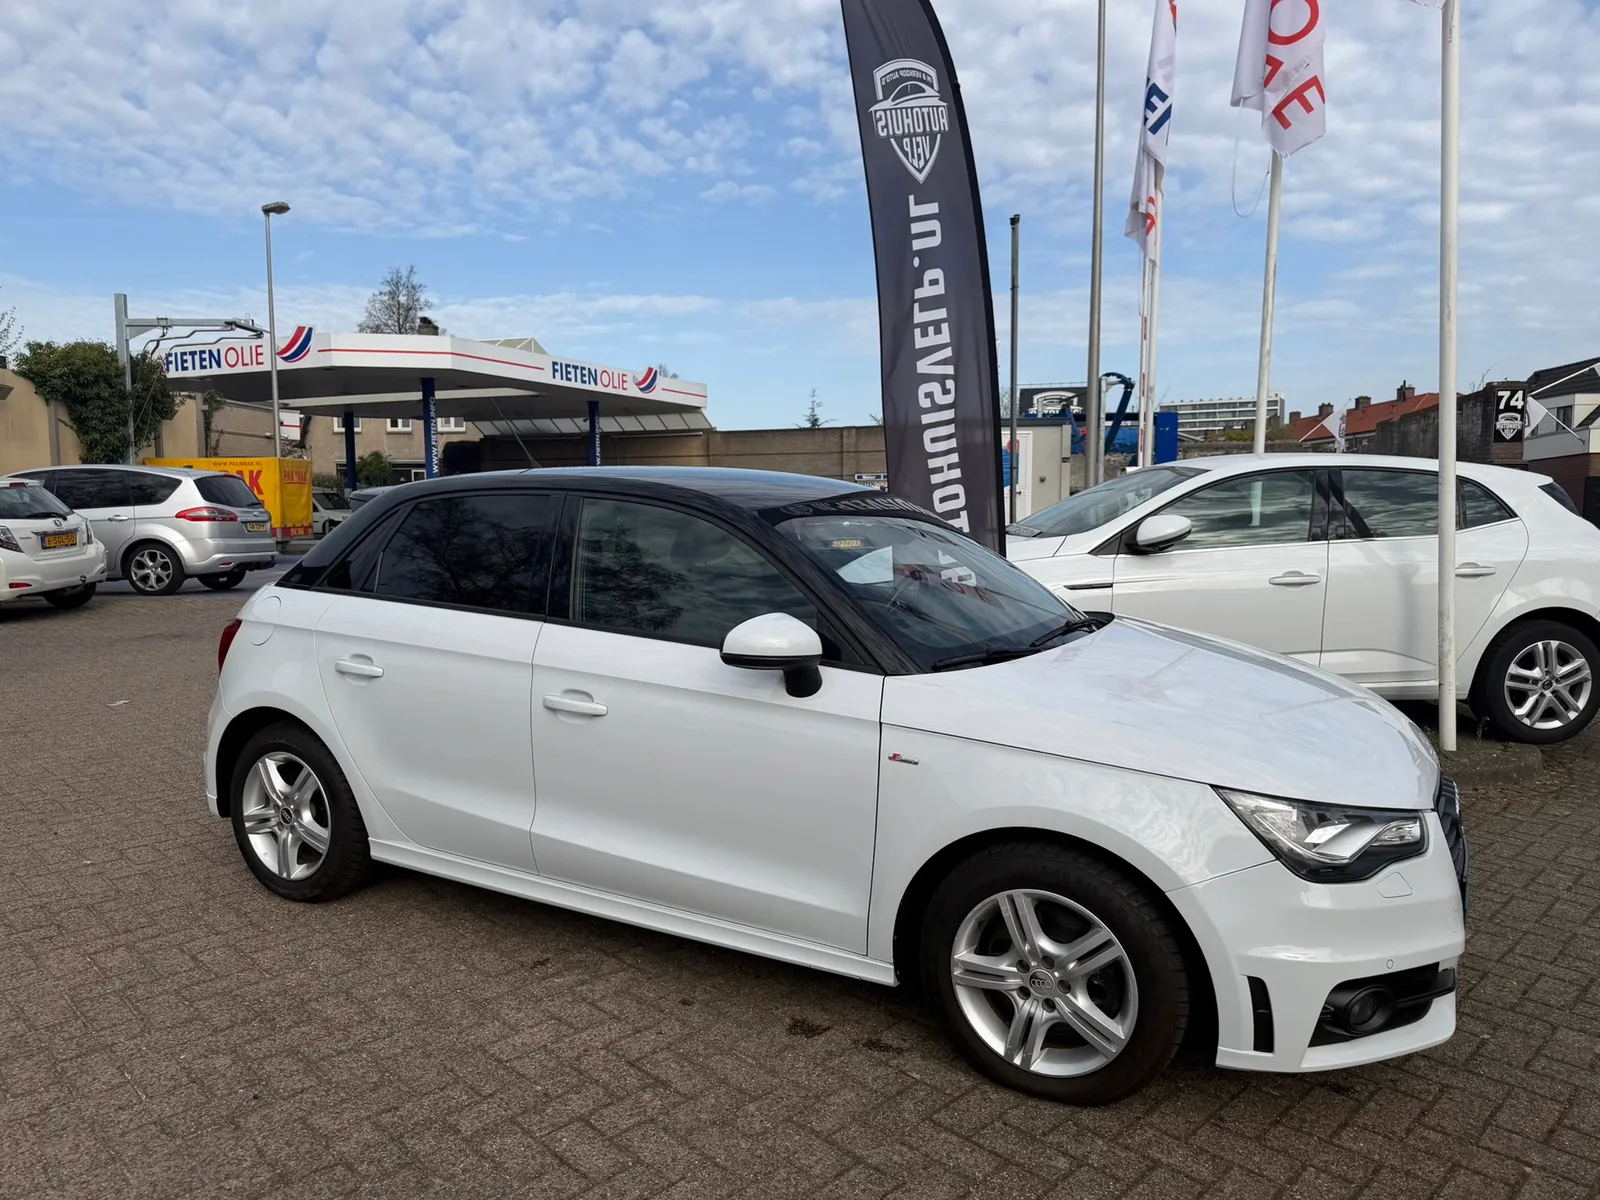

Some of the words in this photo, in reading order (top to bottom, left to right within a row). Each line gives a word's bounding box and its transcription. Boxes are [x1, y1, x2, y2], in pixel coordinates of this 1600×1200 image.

[165, 348, 222, 373] FIETEN
[224, 344, 264, 369] OLIE
[551, 360, 598, 387] FIETEN
[600, 369, 628, 391] OLIE
[1497, 390, 1524, 409] 74
[429, 396, 439, 474] WWW.FIETEN.INFO
